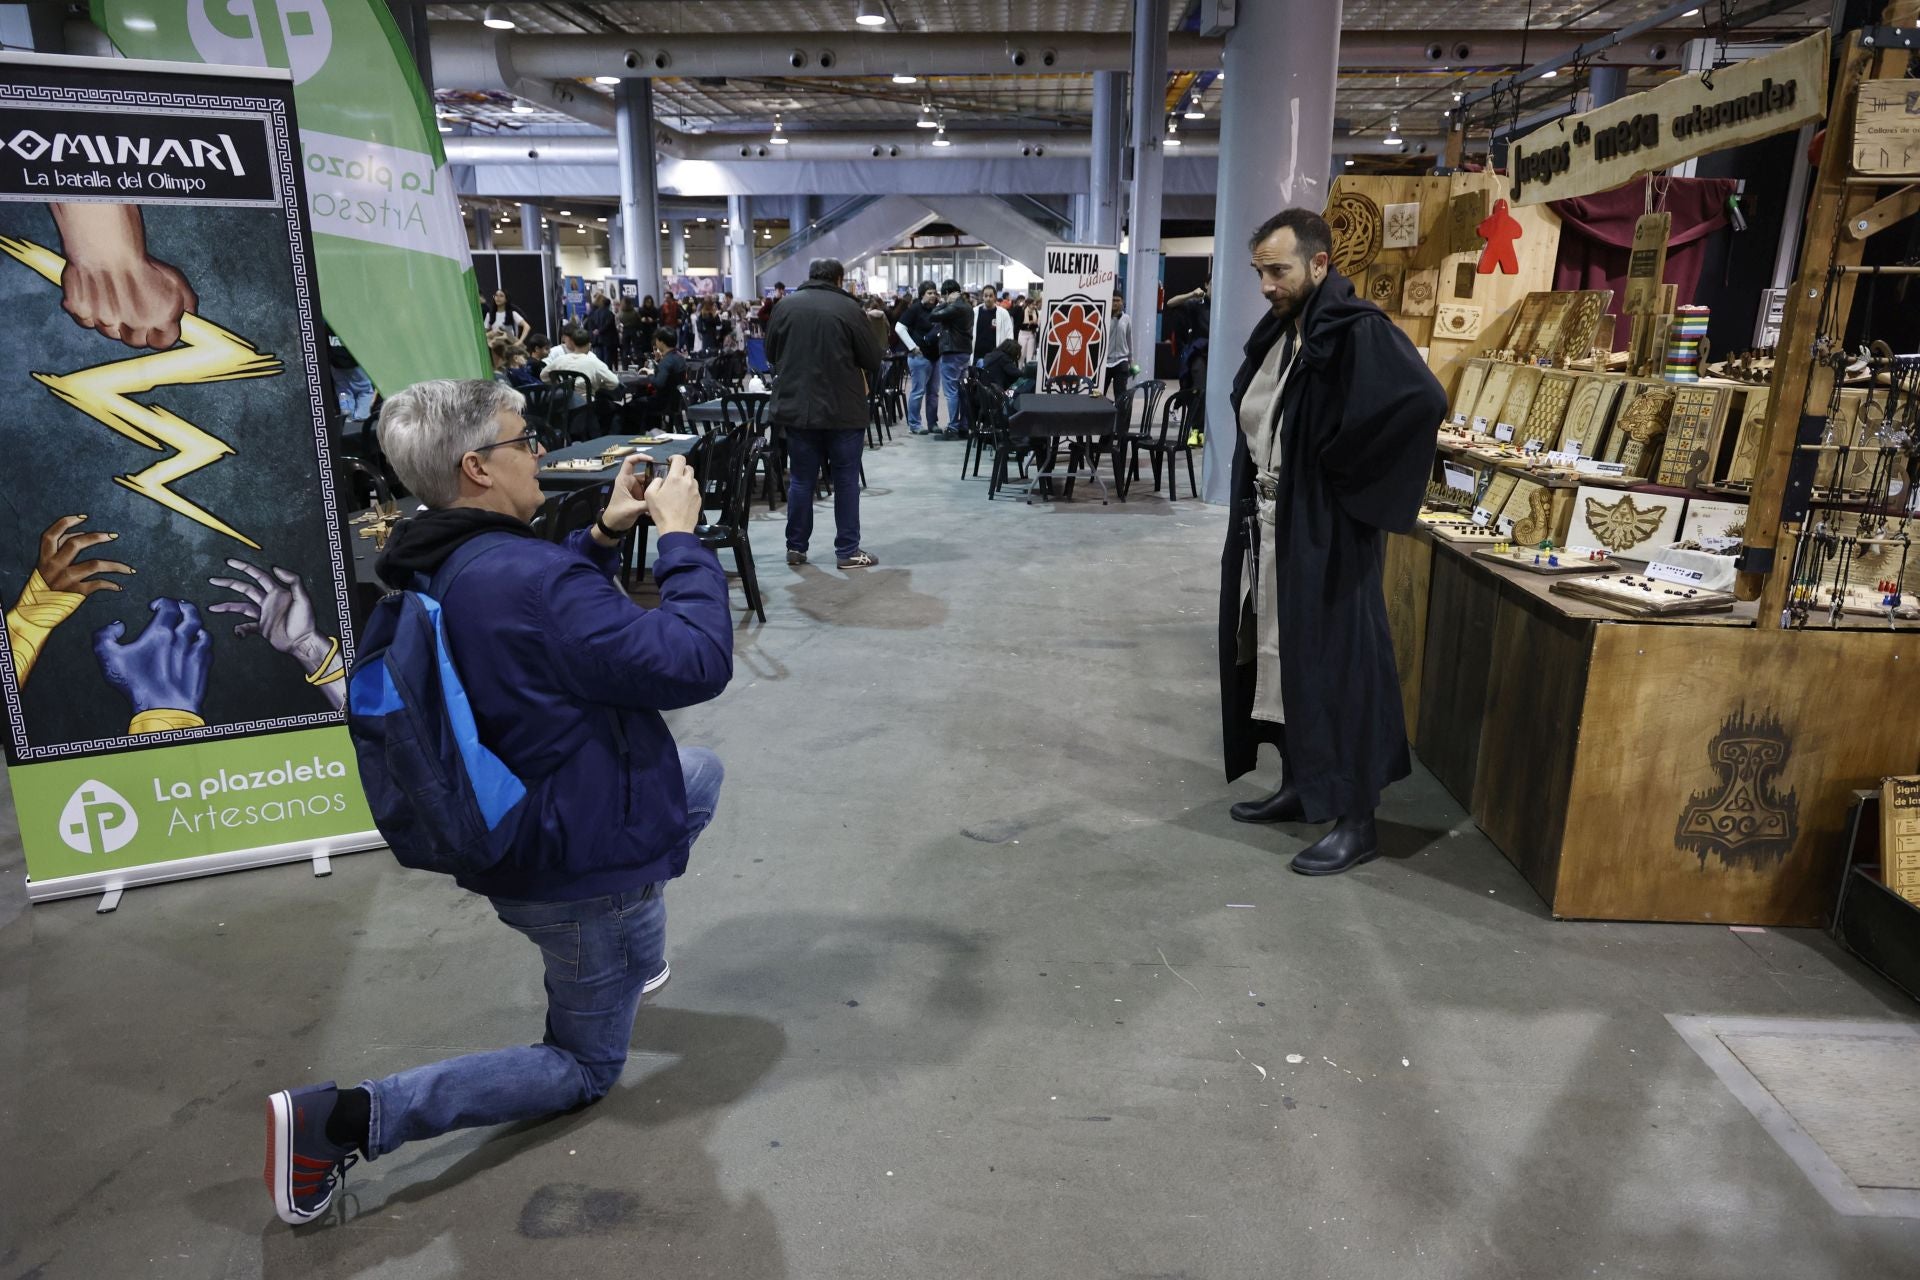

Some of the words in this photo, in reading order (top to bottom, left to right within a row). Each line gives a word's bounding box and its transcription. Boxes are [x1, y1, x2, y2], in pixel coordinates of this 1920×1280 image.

[0, 129, 246, 177] OMINARI
[1510, 142, 1571, 200] Juegos
[1573, 121, 1591, 146] de
[1594, 113, 1660, 162] mesa
[1672, 78, 1797, 140] artesanales
[23, 168, 49, 187] La
[54, 169, 112, 189] batalla
[117, 171, 143, 190] del
[148, 172, 206, 194] Olimpo
[1048, 252, 1099, 275] VALENTIA
[153, 777, 192, 802] La
[200, 756, 346, 800] plazoleta
[1894, 797, 1907, 806] de
[167, 792, 346, 837] Artesanos
